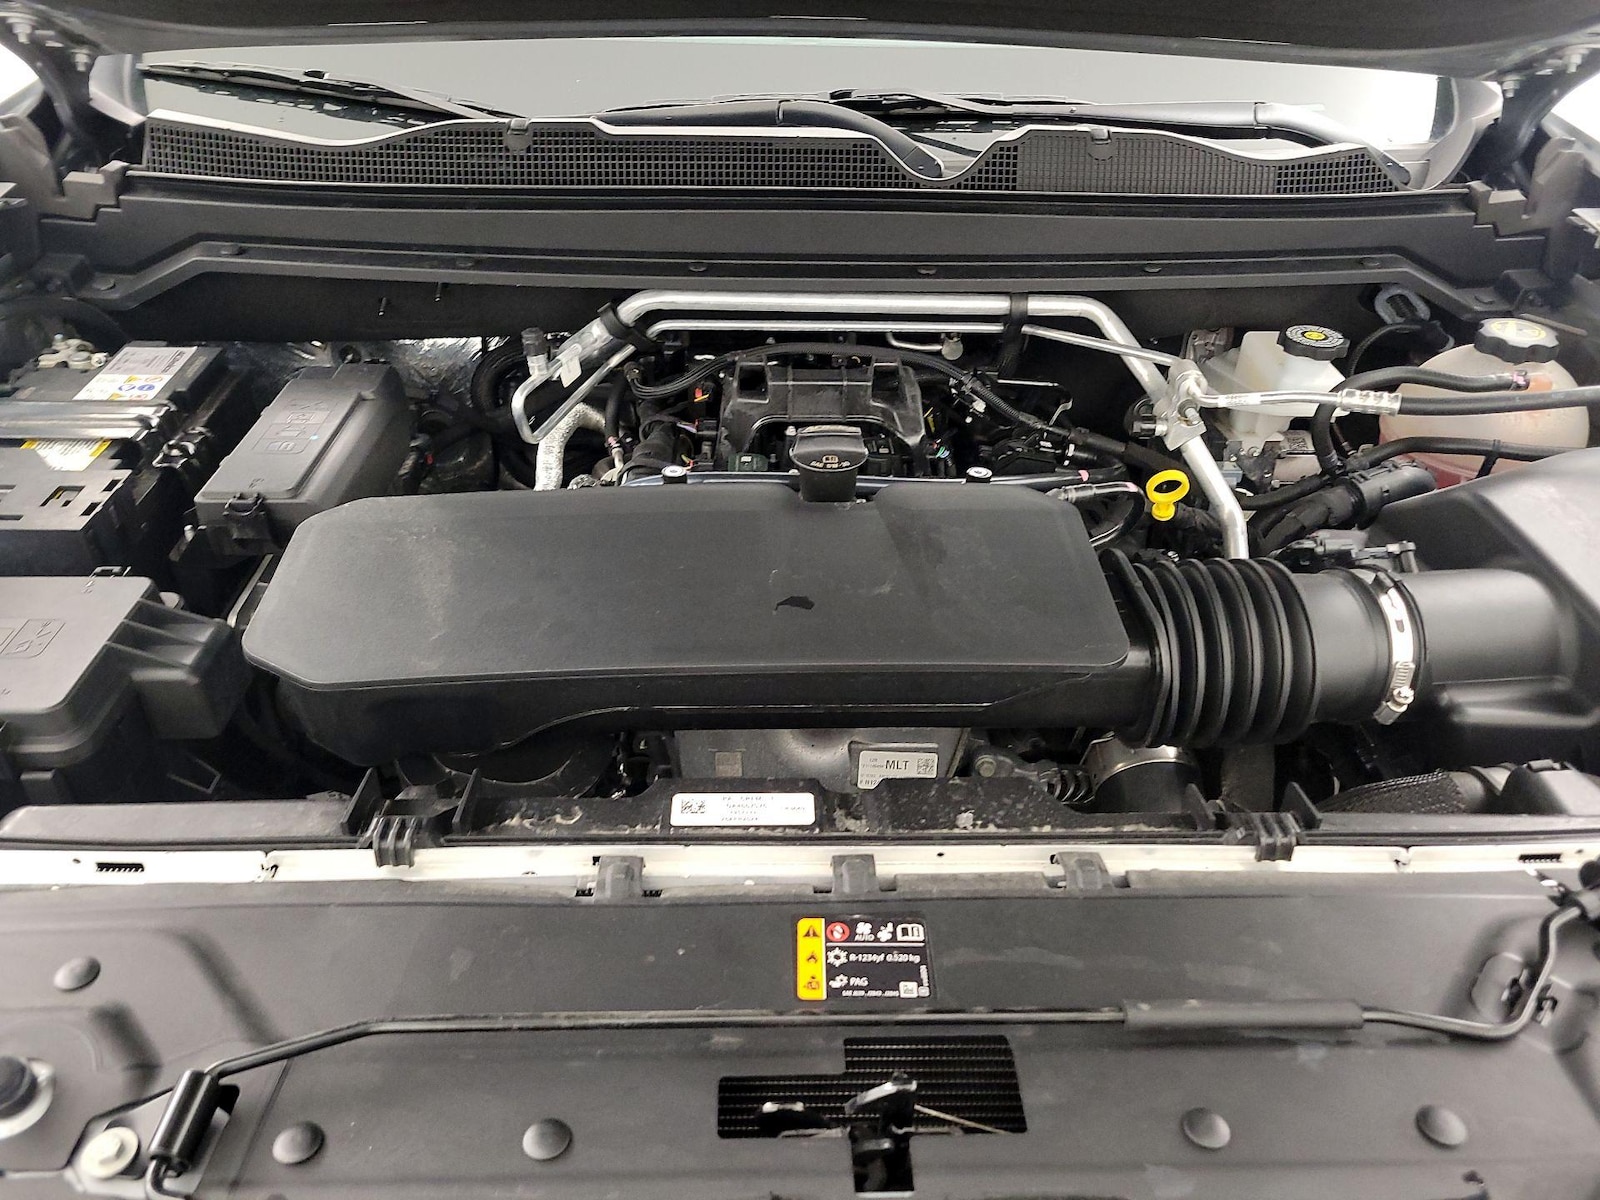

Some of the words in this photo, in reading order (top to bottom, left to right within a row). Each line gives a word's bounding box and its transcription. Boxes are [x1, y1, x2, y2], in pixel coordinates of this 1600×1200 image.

[885, 759, 910, 770] MLT
[854, 934, 875, 942] AUTO
[849, 953, 885, 964] R-1234yf
[909, 953, 921, 964] kg
[849, 977, 869, 987] PAG
